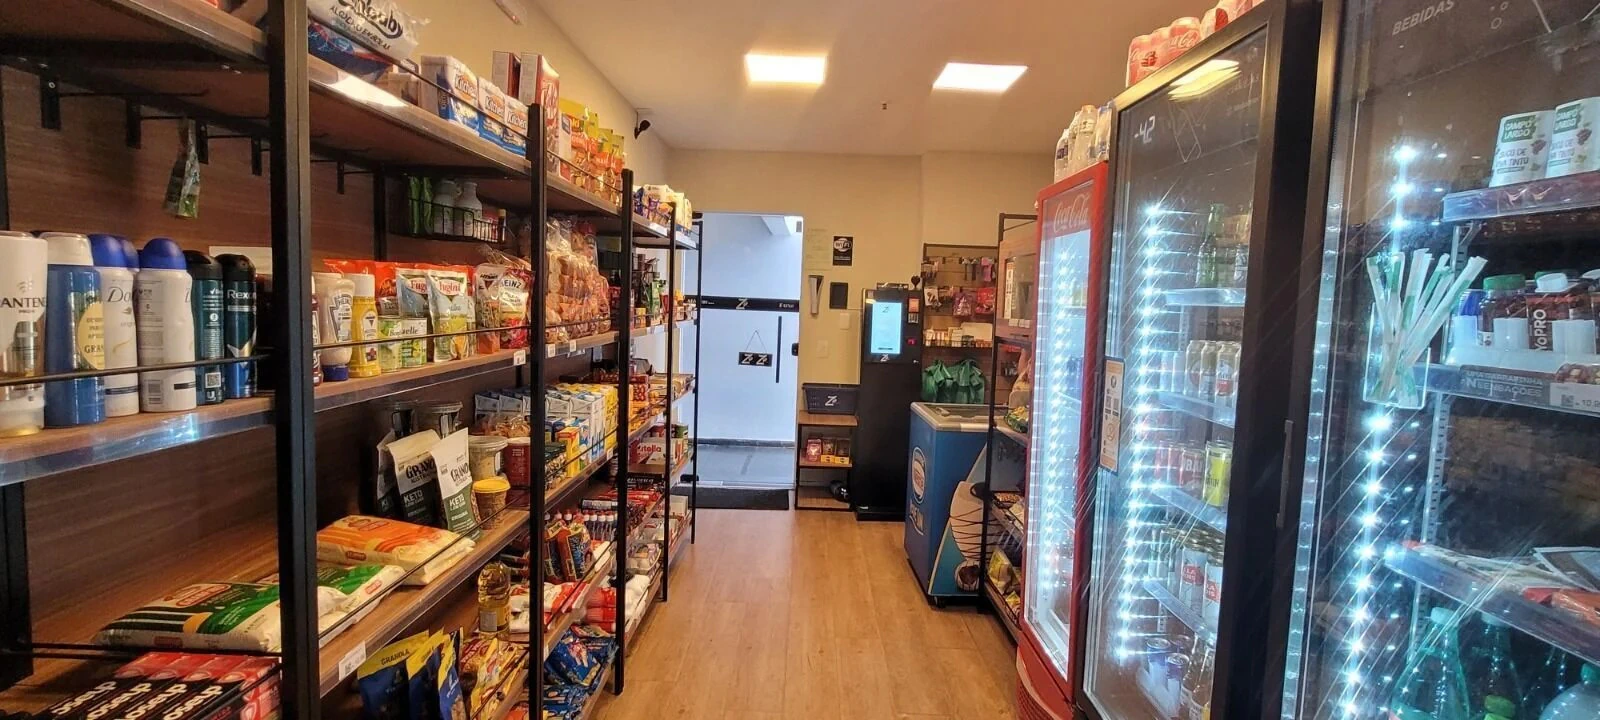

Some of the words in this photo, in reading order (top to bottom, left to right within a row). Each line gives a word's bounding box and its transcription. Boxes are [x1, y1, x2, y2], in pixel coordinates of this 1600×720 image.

[1392, 0, 1454, 36] BEBIDAS
[502, 279, 522, 289] EINZ
[103, 286, 132, 303] Do
[1533, 309, 1548, 352] YoPRO
[405, 459, 434, 479] GRANO
[450, 462, 469, 482] GRANO
[403, 489, 423, 504] KETO
[380, 650, 411, 666] GRANOLA
